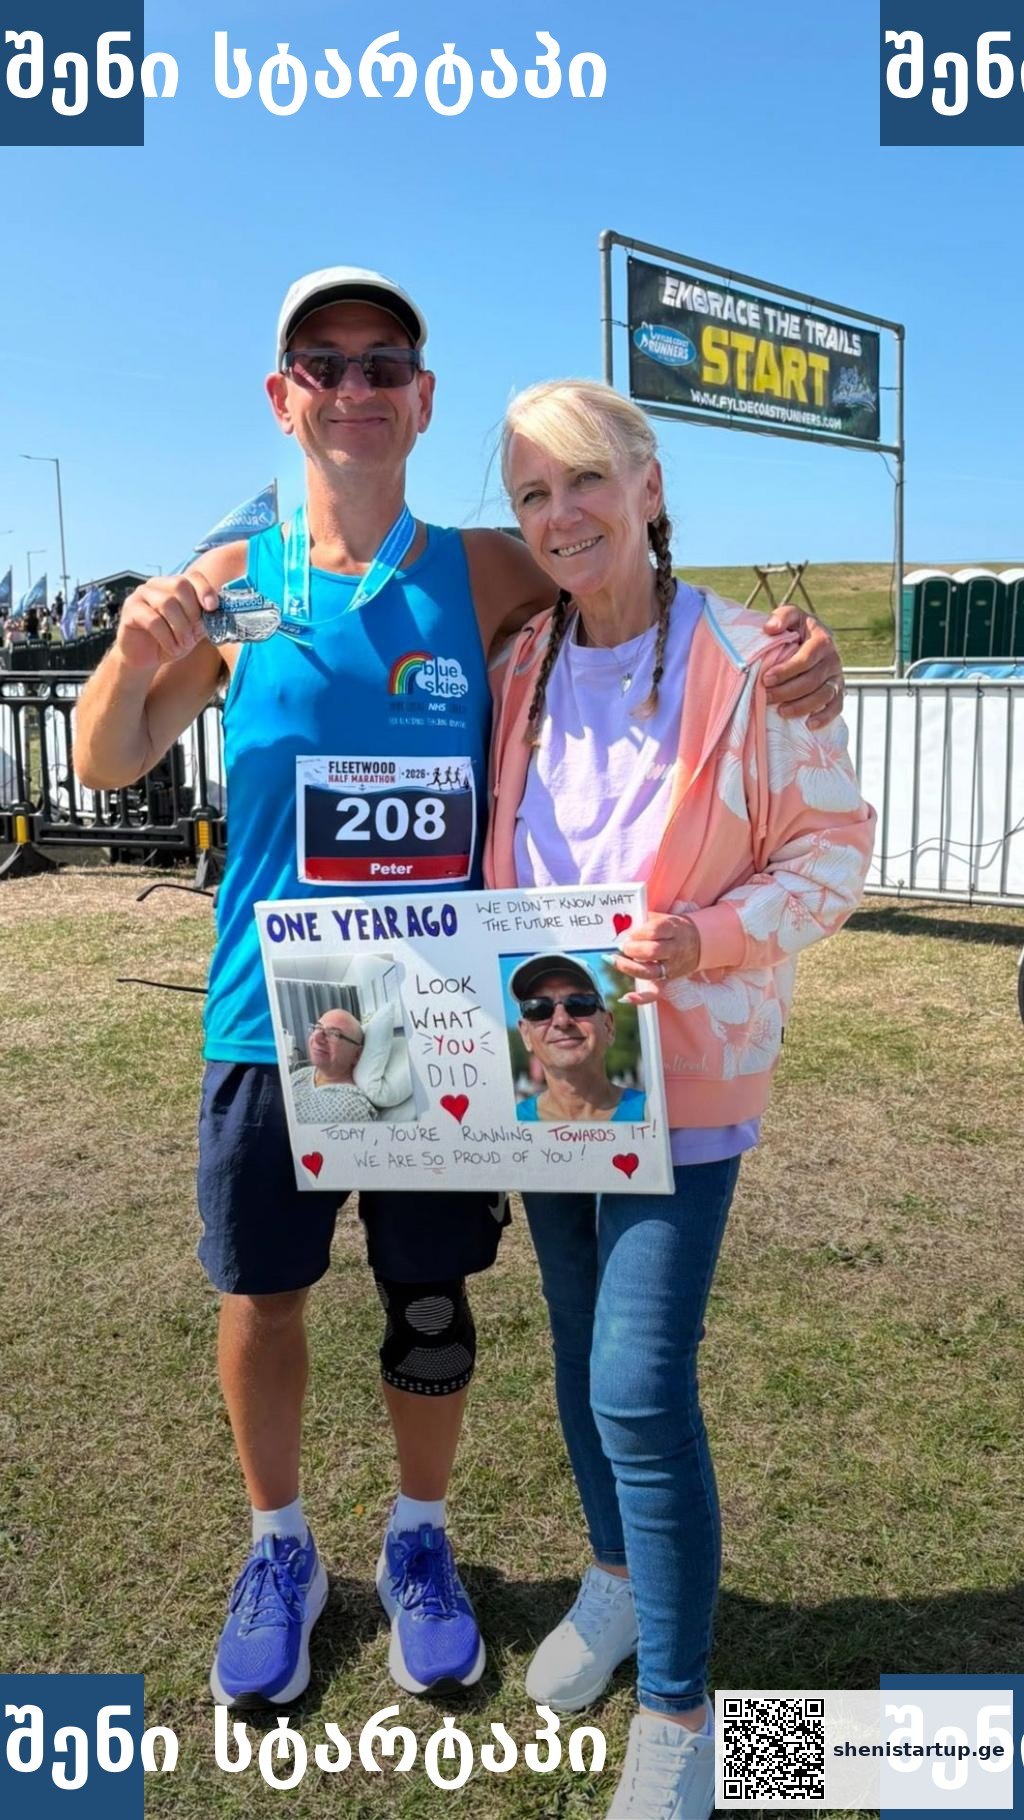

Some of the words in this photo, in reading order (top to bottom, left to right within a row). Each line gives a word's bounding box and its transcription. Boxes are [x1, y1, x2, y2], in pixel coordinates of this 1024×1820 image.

[662, 275, 761, 330] EMBRACE
[763, 306, 802, 341] THE
[803, 317, 863, 358] TRAILS
[701, 325, 830, 408] START
[423, 658, 458, 677] blue
[424, 680, 467, 695] skies
[428, 703, 446, 712] NHS
[328, 761, 396, 774] FLEETWOOD
[328, 774, 349, 783] HALF
[351, 774, 396, 784] MARATHON
[335, 797, 446, 841] 208
[370, 863, 413, 875] Peter
[476, 900, 501, 914] WE
[559, 895, 597, 909] KNOW
[599, 894, 635, 905] WHAT
[266, 912, 322, 943] ONE
[331, 906, 404, 941] YEAR
[406, 903, 458, 937] AGO
[482, 918, 511, 932] THE
[515, 915, 563, 931] FUTURE
[570, 913, 604, 927] HELD
[415, 974, 477, 995] LOOK
[410, 1006, 482, 1030] WHAT
[433, 1034, 475, 1056] YOU
[427, 1063, 487, 1088] DID.
[386, 1124, 440, 1142] YOU'RE
[462, 1124, 533, 1143] RUNNING
[548, 1125, 617, 1142] TOWARDS
[631, 1119, 657, 1140] IT!
[354, 1154, 380, 1168] WE
[387, 1152, 416, 1169] ARE
[422, 1151, 445, 1166] SO
[453, 1149, 501, 1164] PROUD
[512, 1150, 529, 1163] OF
